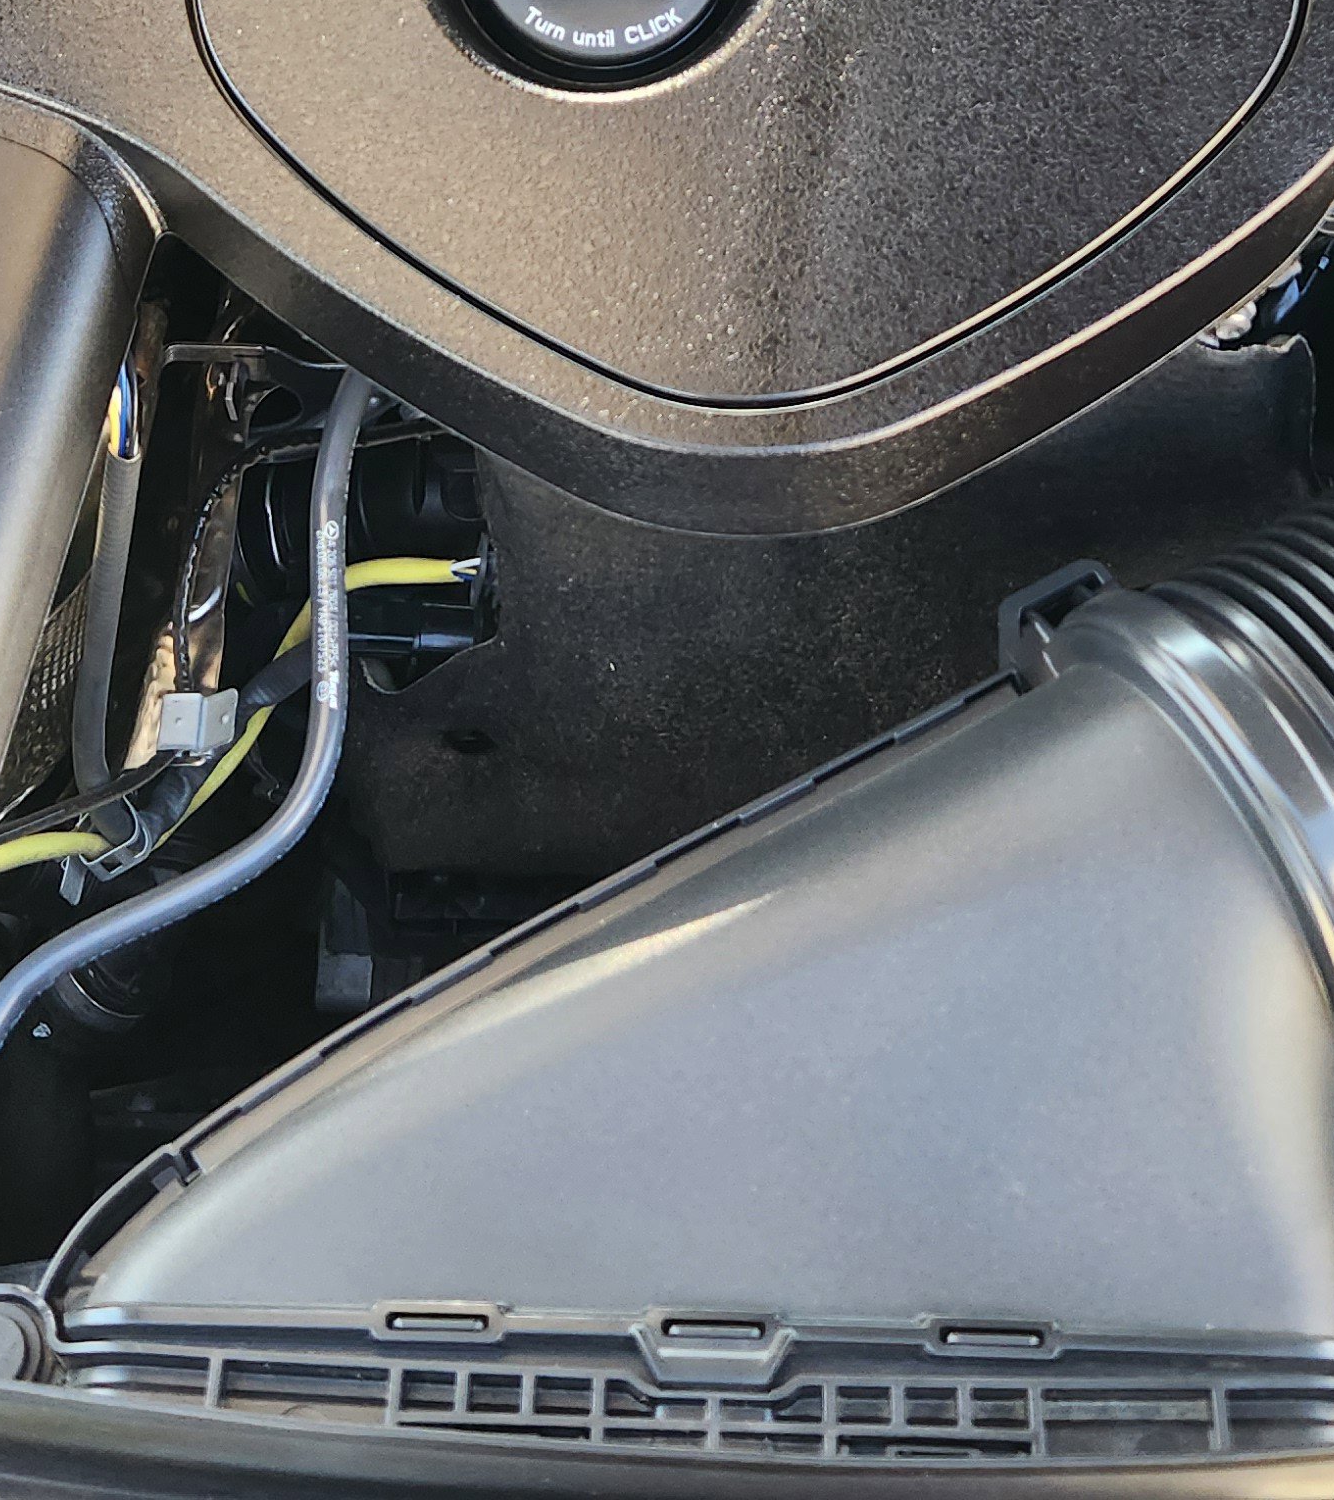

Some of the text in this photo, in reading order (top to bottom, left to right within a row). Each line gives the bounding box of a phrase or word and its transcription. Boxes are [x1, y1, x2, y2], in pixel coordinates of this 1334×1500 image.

[524, 5, 684, 48] Turn until CLICK
